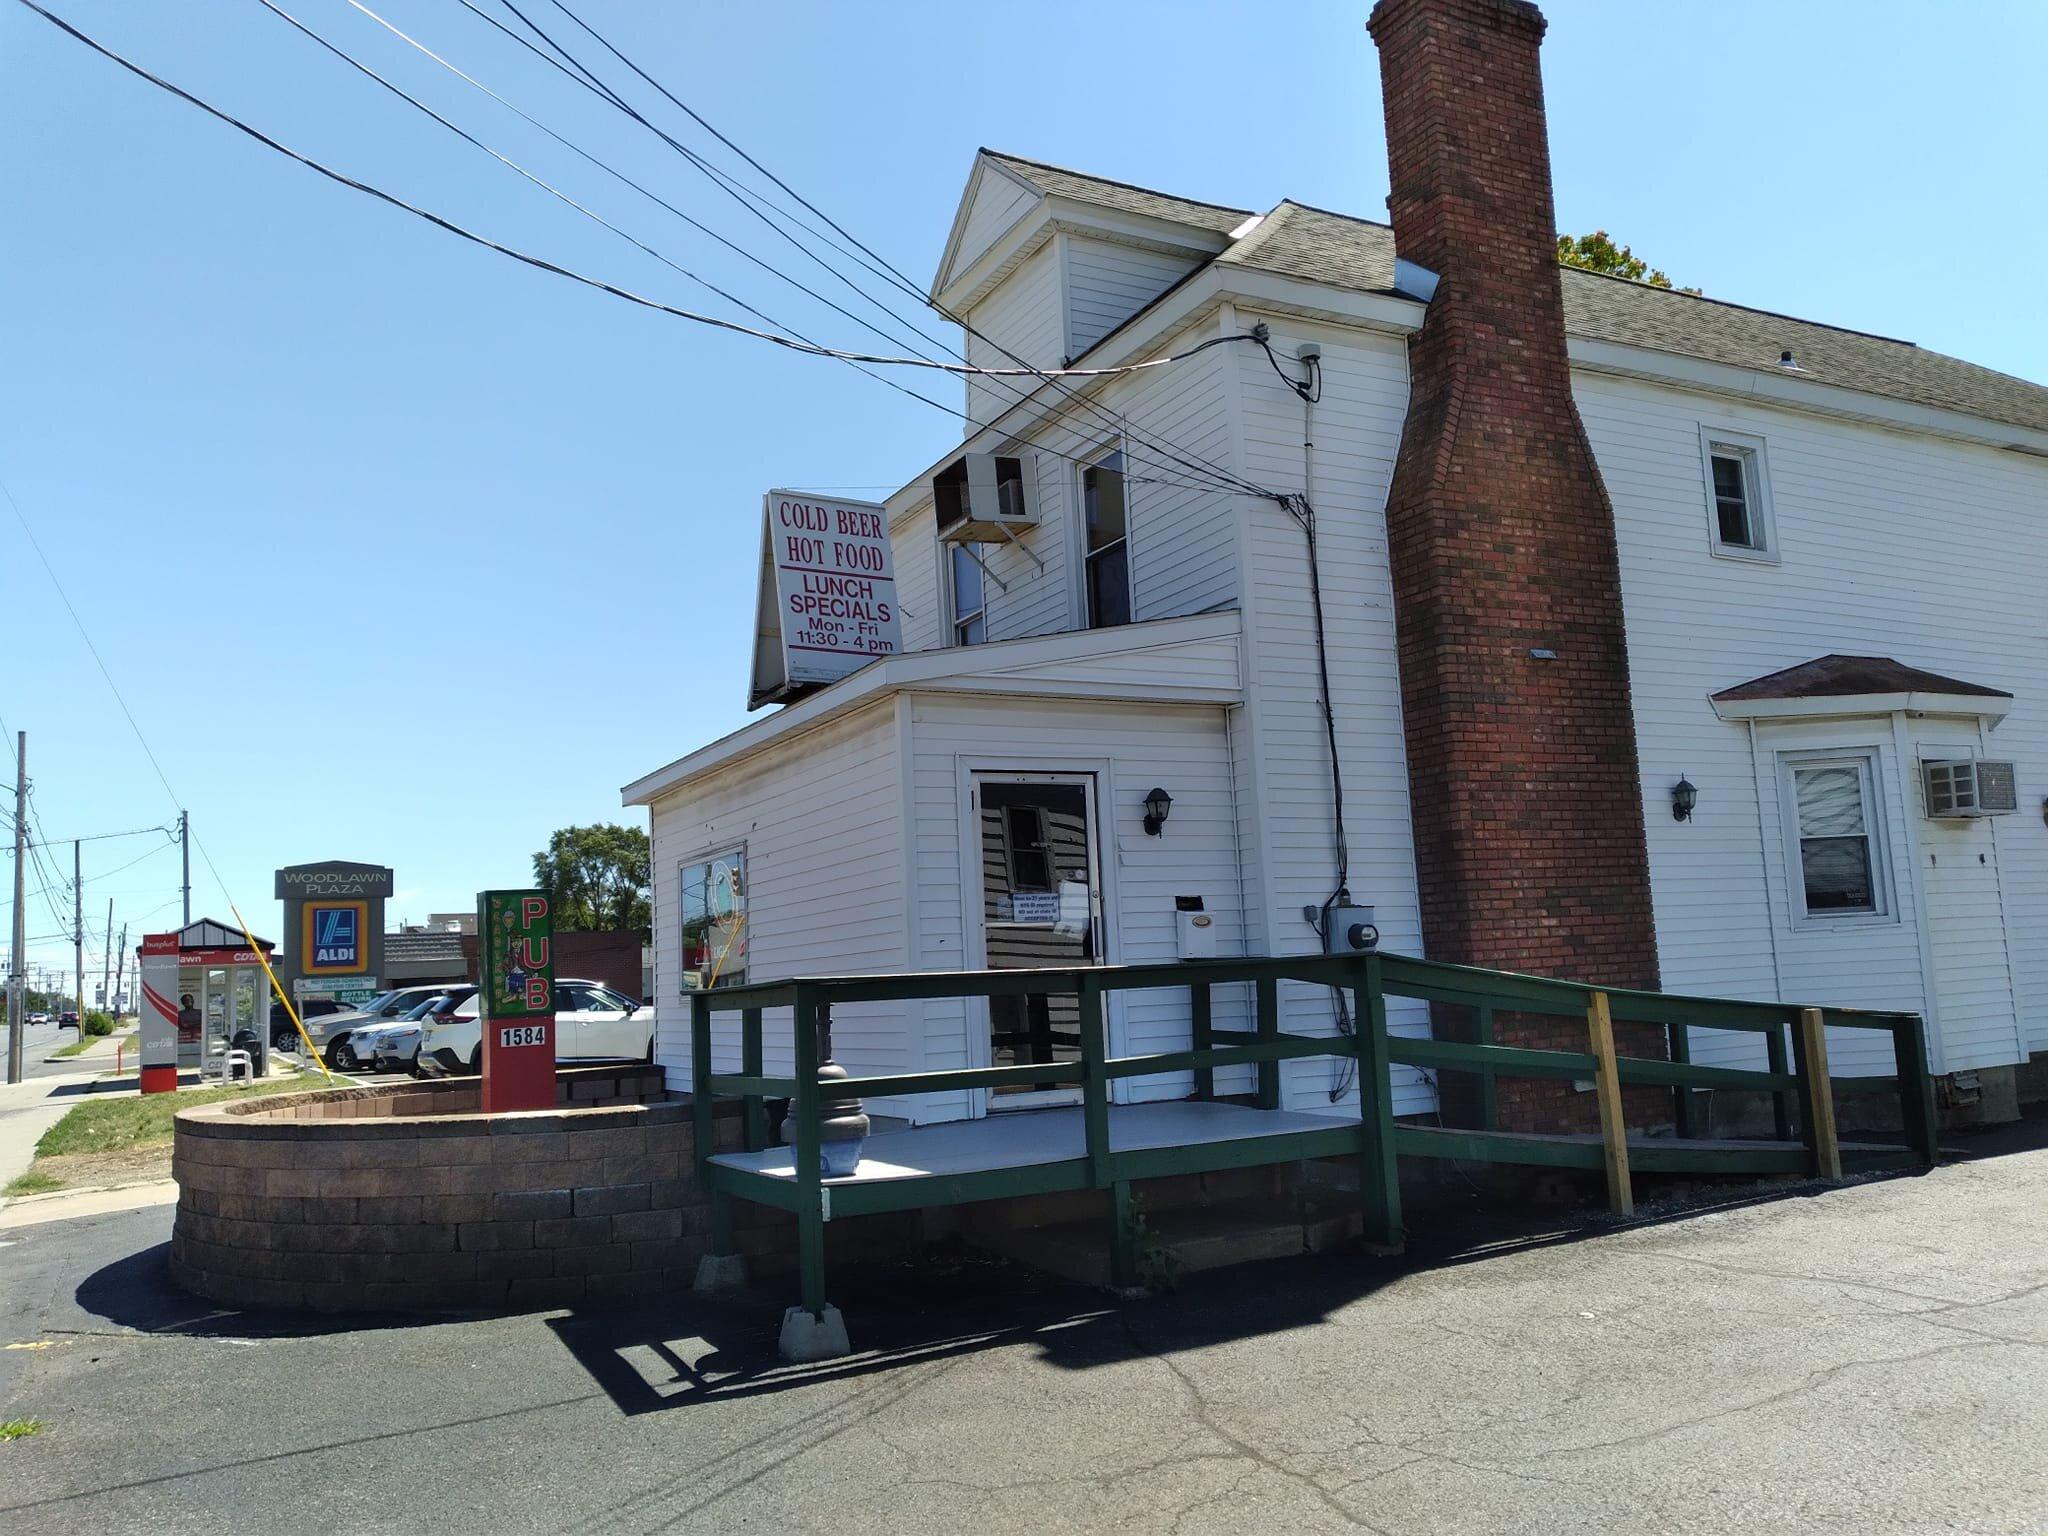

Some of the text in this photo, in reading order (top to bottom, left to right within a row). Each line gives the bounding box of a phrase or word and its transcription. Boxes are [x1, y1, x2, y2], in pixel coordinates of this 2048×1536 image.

[780, 501, 883, 539] COLD BEER
[786, 536, 883, 571] HOT FOOD
[803, 574, 873, 599] LUNCH
[790, 594, 890, 622] SPECIALS
[808, 617, 844, 633] Mon
[859, 623, 879, 636] Fri
[797, 630, 838, 646] 11:30
[853, 636, 864, 649] 4
[868, 639, 893, 652] pm
[284, 873, 387, 884] WOODLAWN
[305, 884, 364, 894] PLAZA
[317, 948, 354, 961] ALDI
[522, 897, 550, 1010] PUB
[503, 1027, 544, 1046] 1584
